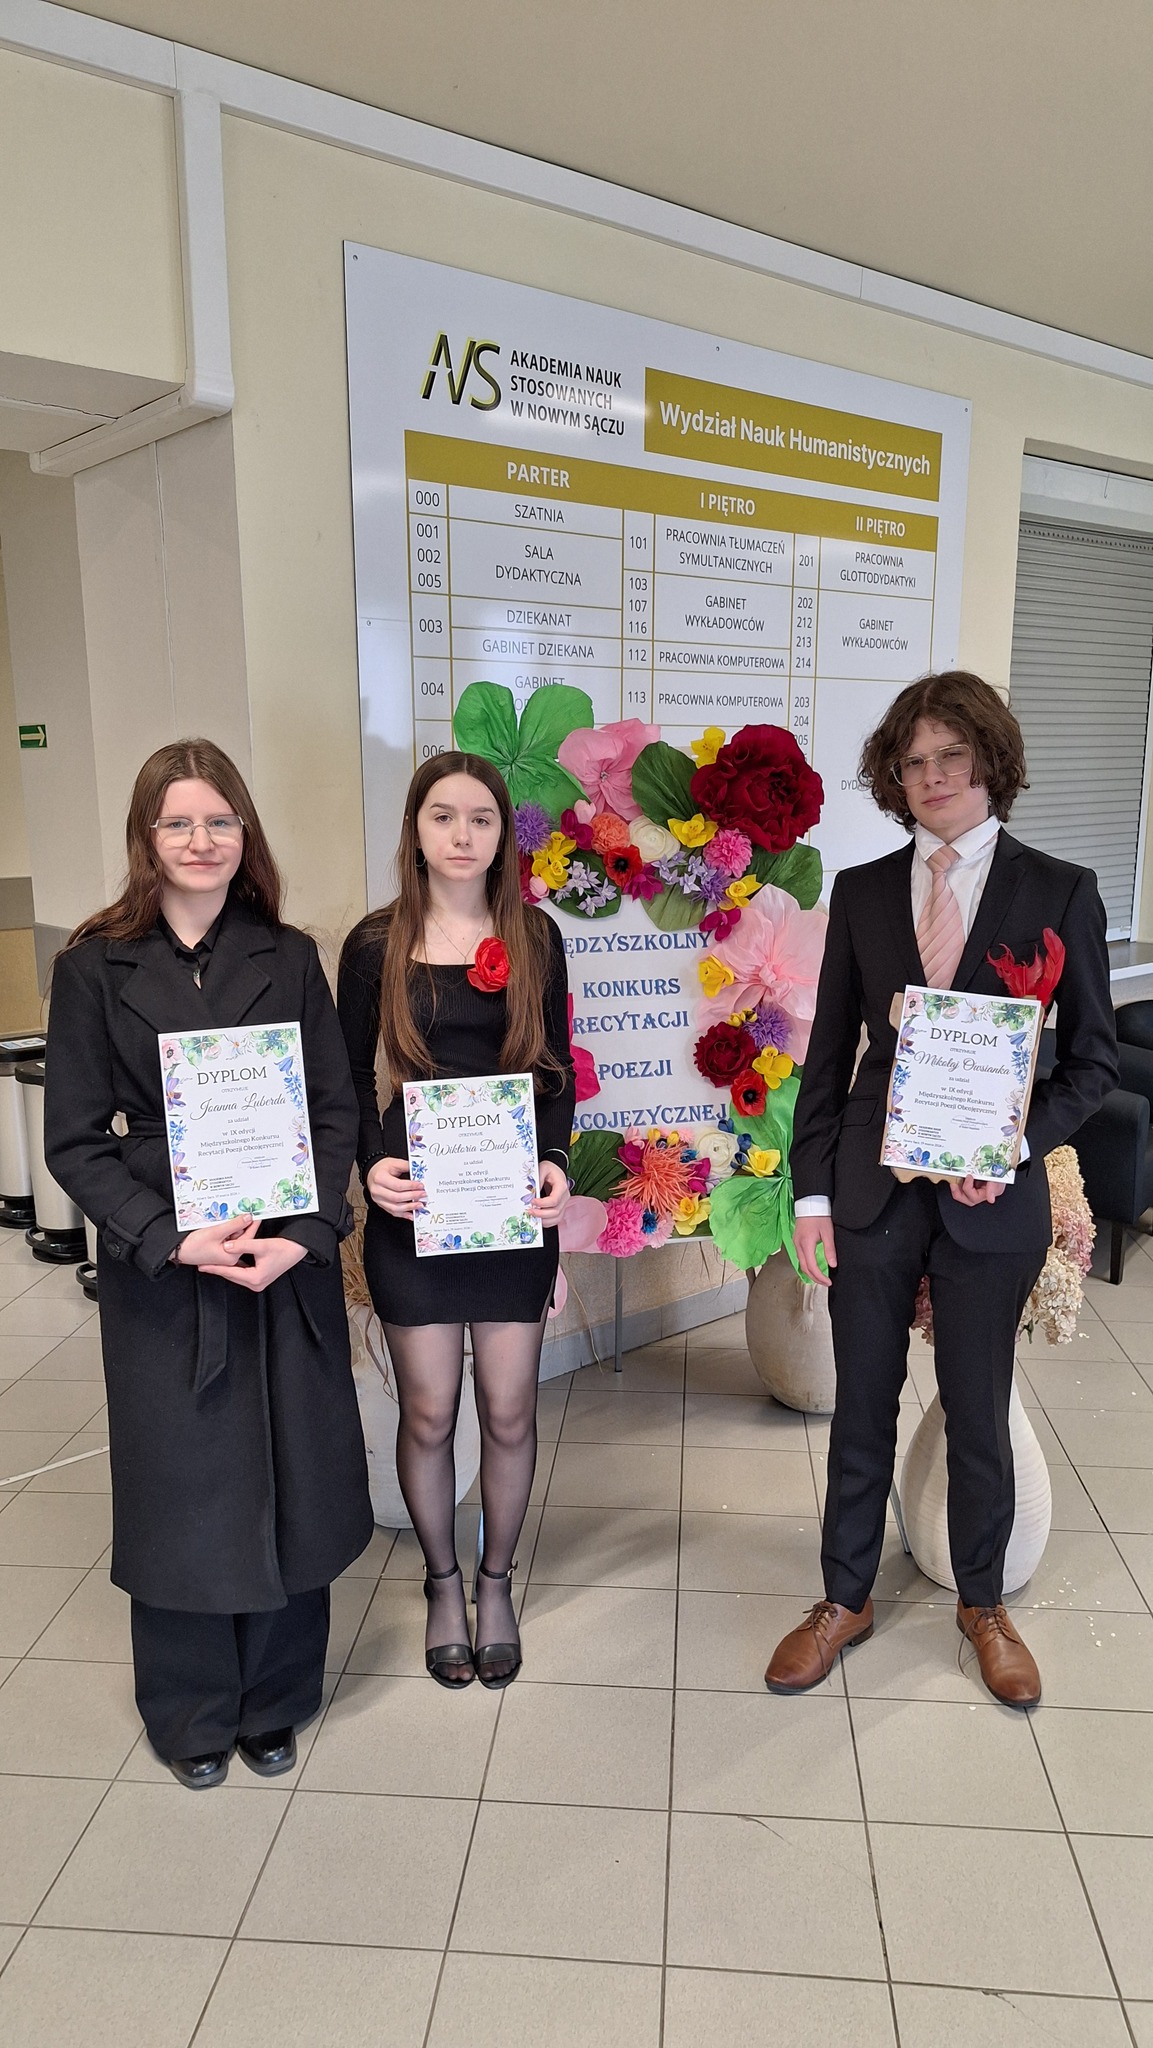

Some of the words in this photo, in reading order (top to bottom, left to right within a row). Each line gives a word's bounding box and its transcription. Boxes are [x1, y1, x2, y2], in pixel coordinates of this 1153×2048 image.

[510, 349, 582, 380] AKADEMIA
[586, 366, 622, 388] NAUK
[510, 375, 612, 410] STOSOWANYCH
[510, 400, 524, 417] W
[528, 403, 580, 428] NOWYM
[584, 414, 625, 436] SĄCZU
[659, 400, 737, 438] Wydział
[740, 418, 785, 448] Nauk
[790, 429, 931, 477] Humanistycznych
[507, 461, 570, 489] PARTER
[415, 490, 440, 507] 000
[700, 493, 705, 509] I
[708, 493, 756, 517] PIĘTRO
[514, 504, 565, 523] SZATNIA
[416, 523, 439, 539] 001
[856, 516, 863, 532] II
[866, 518, 906, 538] PIĘTRO
[629, 536, 647, 550] 101
[666, 528, 727, 548] PRACOWNIA
[729, 536, 785, 555] TŁUMACZEŃ
[417, 548, 441, 564] 002
[525, 545, 554, 560] SALA
[799, 554, 814, 567] 201
[855, 551, 904, 568] PRACOWNIA
[680, 552, 773, 574] SYMULTANICZNYCH
[418, 573, 442, 588] 005
[495, 565, 582, 586] DYDAKTYCZNA
[629, 577, 648, 591] 103
[840, 569, 916, 588] GLOTTODYDAKTYKI
[629, 599, 647, 612] 107
[705, 595, 747, 610] GABINET
[797, 597, 813, 609] 202
[419, 619, 443, 634] 003
[507, 609, 572, 628] DZIEKANAT
[685, 614, 765, 632] WYKŁADOWCÓW
[796, 616, 813, 629] 212
[859, 618, 894, 631] GABINET
[629, 621, 647, 634] 116
[482, 639, 535, 655] GABINET
[538, 643, 595, 659] DZIEKANA
[796, 636, 812, 648] 213
[842, 636, 908, 651] WYKŁADOWCÓW
[628, 649, 647, 662] 112
[659, 651, 715, 666] PRACOWNIA
[717, 655, 785, 669] KOMPUTEROWA
[795, 657, 811, 669] 214
[421, 682, 445, 696] 004
[515, 675, 566, 689] GABINET
[628, 691, 646, 704] 113
[658, 693, 714, 706] PRACOWNIA
[716, 695, 784, 708] KOMPUTEROWA
[794, 696, 810, 708] 203
[793, 715, 809, 727] 204
[562, 929, 713, 958] ĘDZYSZKOLNY
[583, 978, 681, 999] KONKURS
[572, 1010, 690, 1035] RECYTACJI
[929, 1028, 998, 1047] DYPLOM
[197, 1066, 268, 1086] DYPLOM
[598, 1059, 673, 1080] POEZJI
[956, 1088, 973, 1096] edycji
[190, 1098, 238, 1121] Joanna
[437, 1113, 501, 1130] DYPLOM
[238, 1127, 256, 1135] edycji
[428, 1142, 477, 1157] Wiktoria
[480, 1139, 519, 1154] Dudzik
